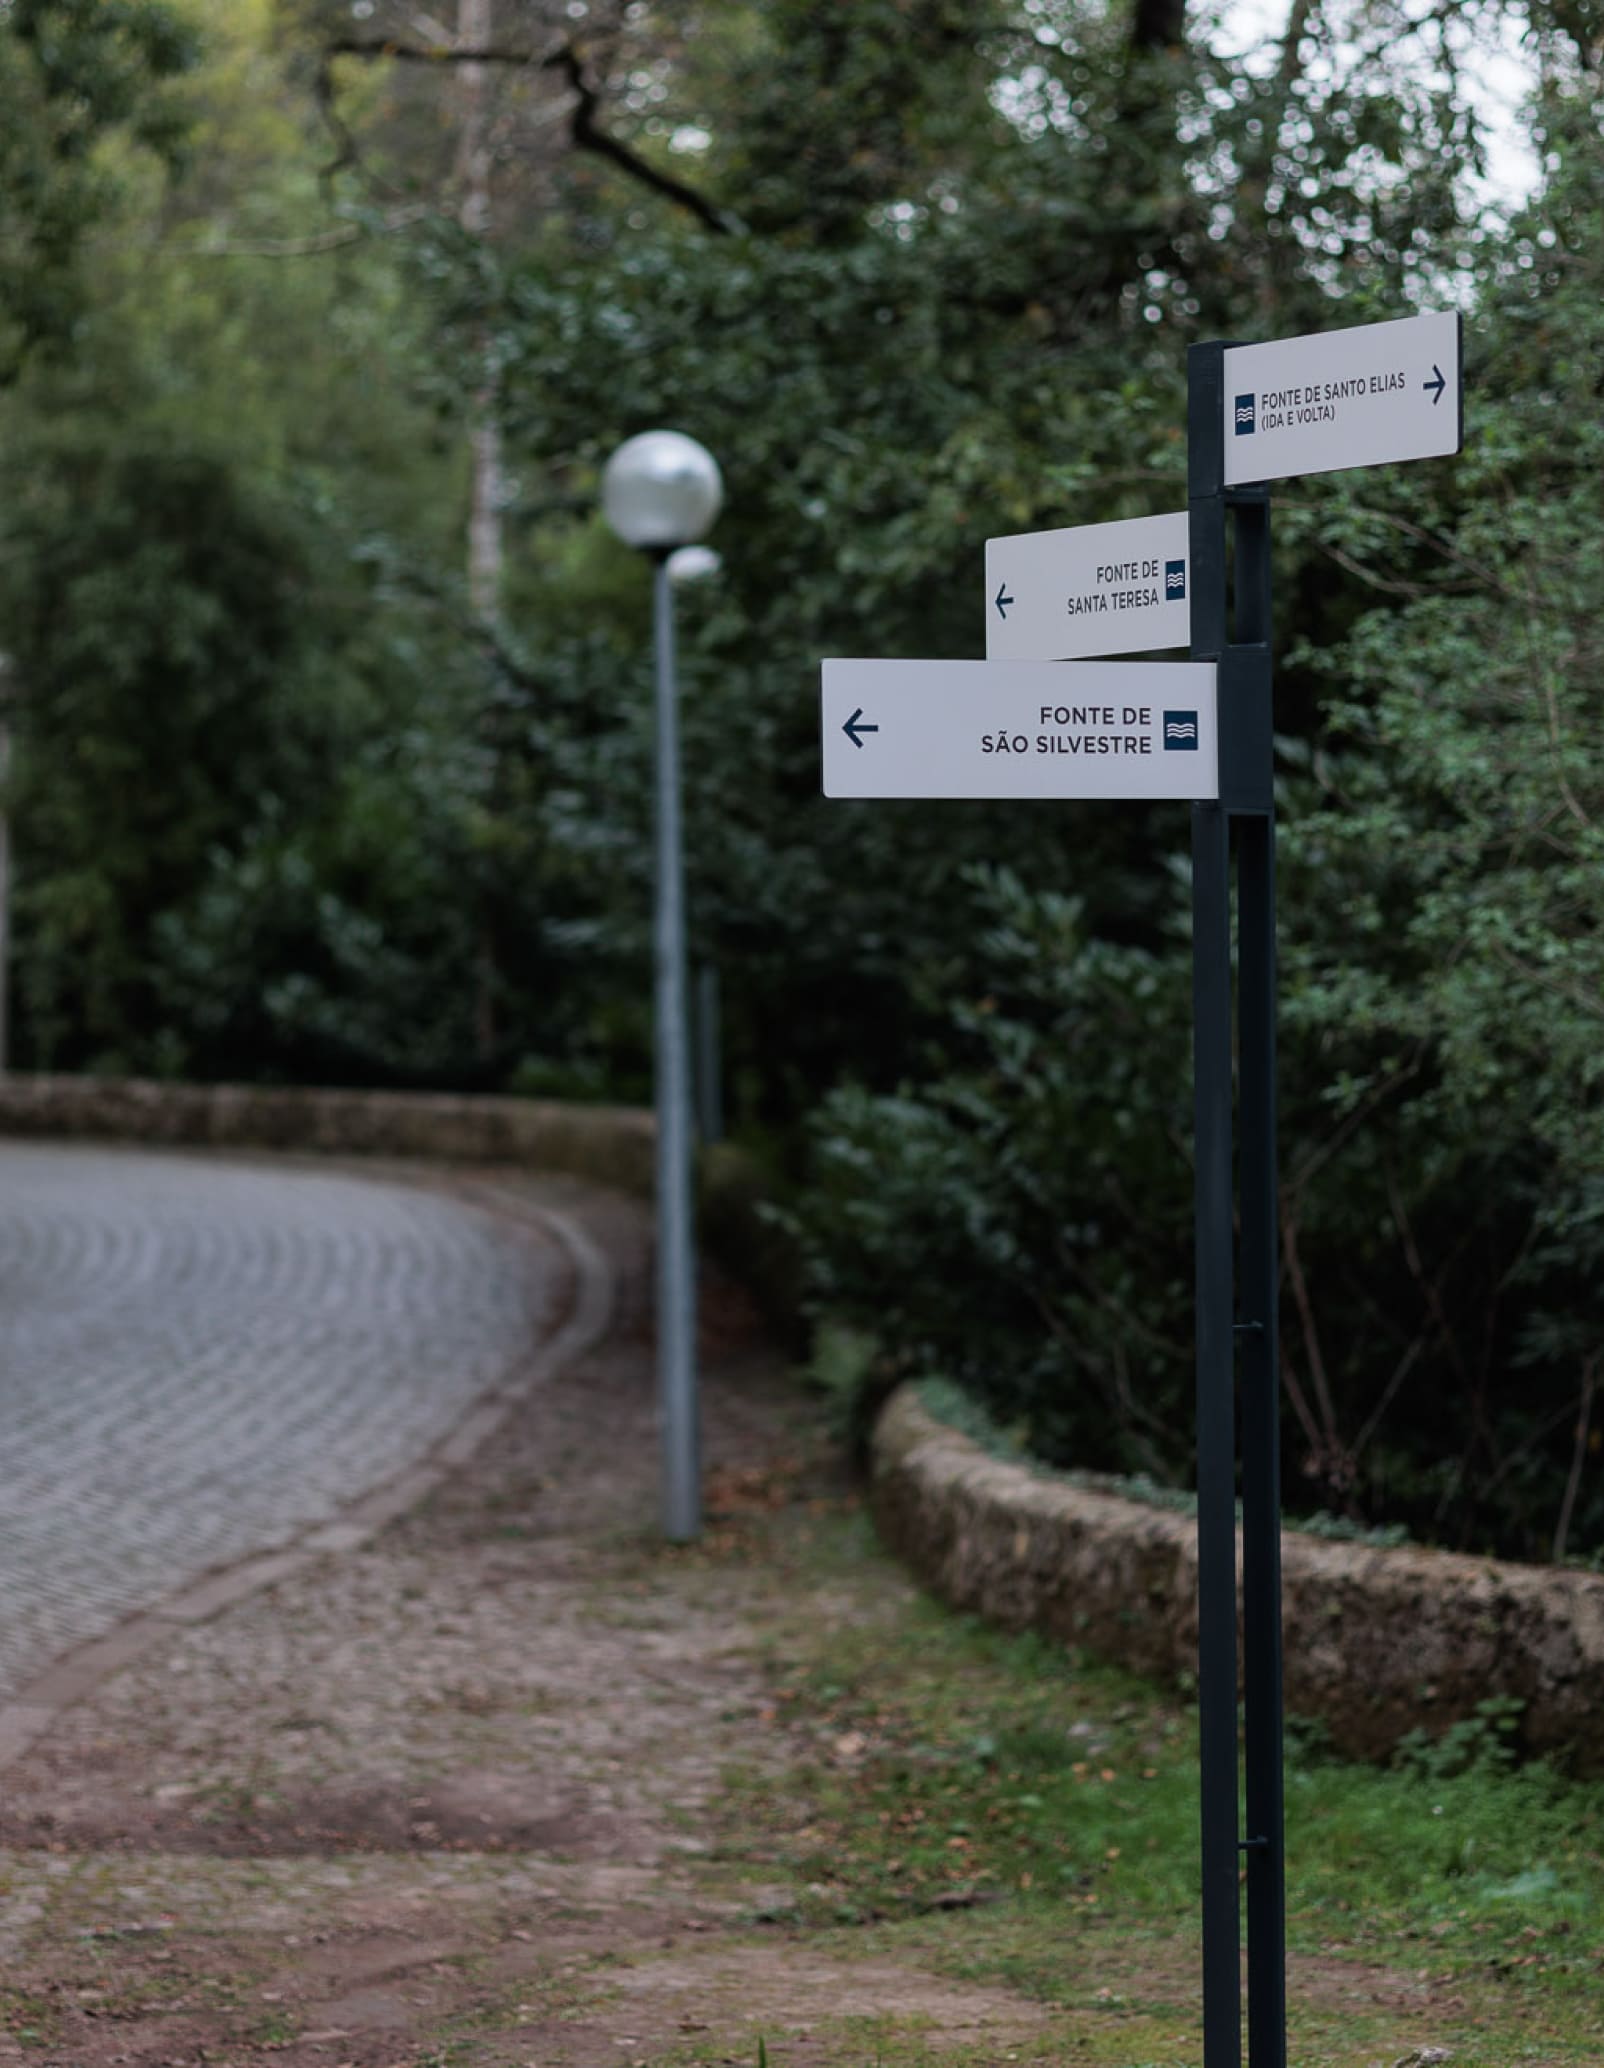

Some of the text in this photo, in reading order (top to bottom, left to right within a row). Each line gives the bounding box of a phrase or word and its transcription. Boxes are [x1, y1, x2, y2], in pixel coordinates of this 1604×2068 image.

[1262, 373, 1405, 410] FONTE DE SANTO ELIAS
[1261, 405, 1335, 431] (IDA E VOLTA)
[1096, 560, 1159, 584] FONTE DE
[1068, 589, 1159, 615] SANTA TERESA
[1040, 707, 1152, 725] FONTE DE
[981, 730, 1152, 754] SÃO SILVESTRE
